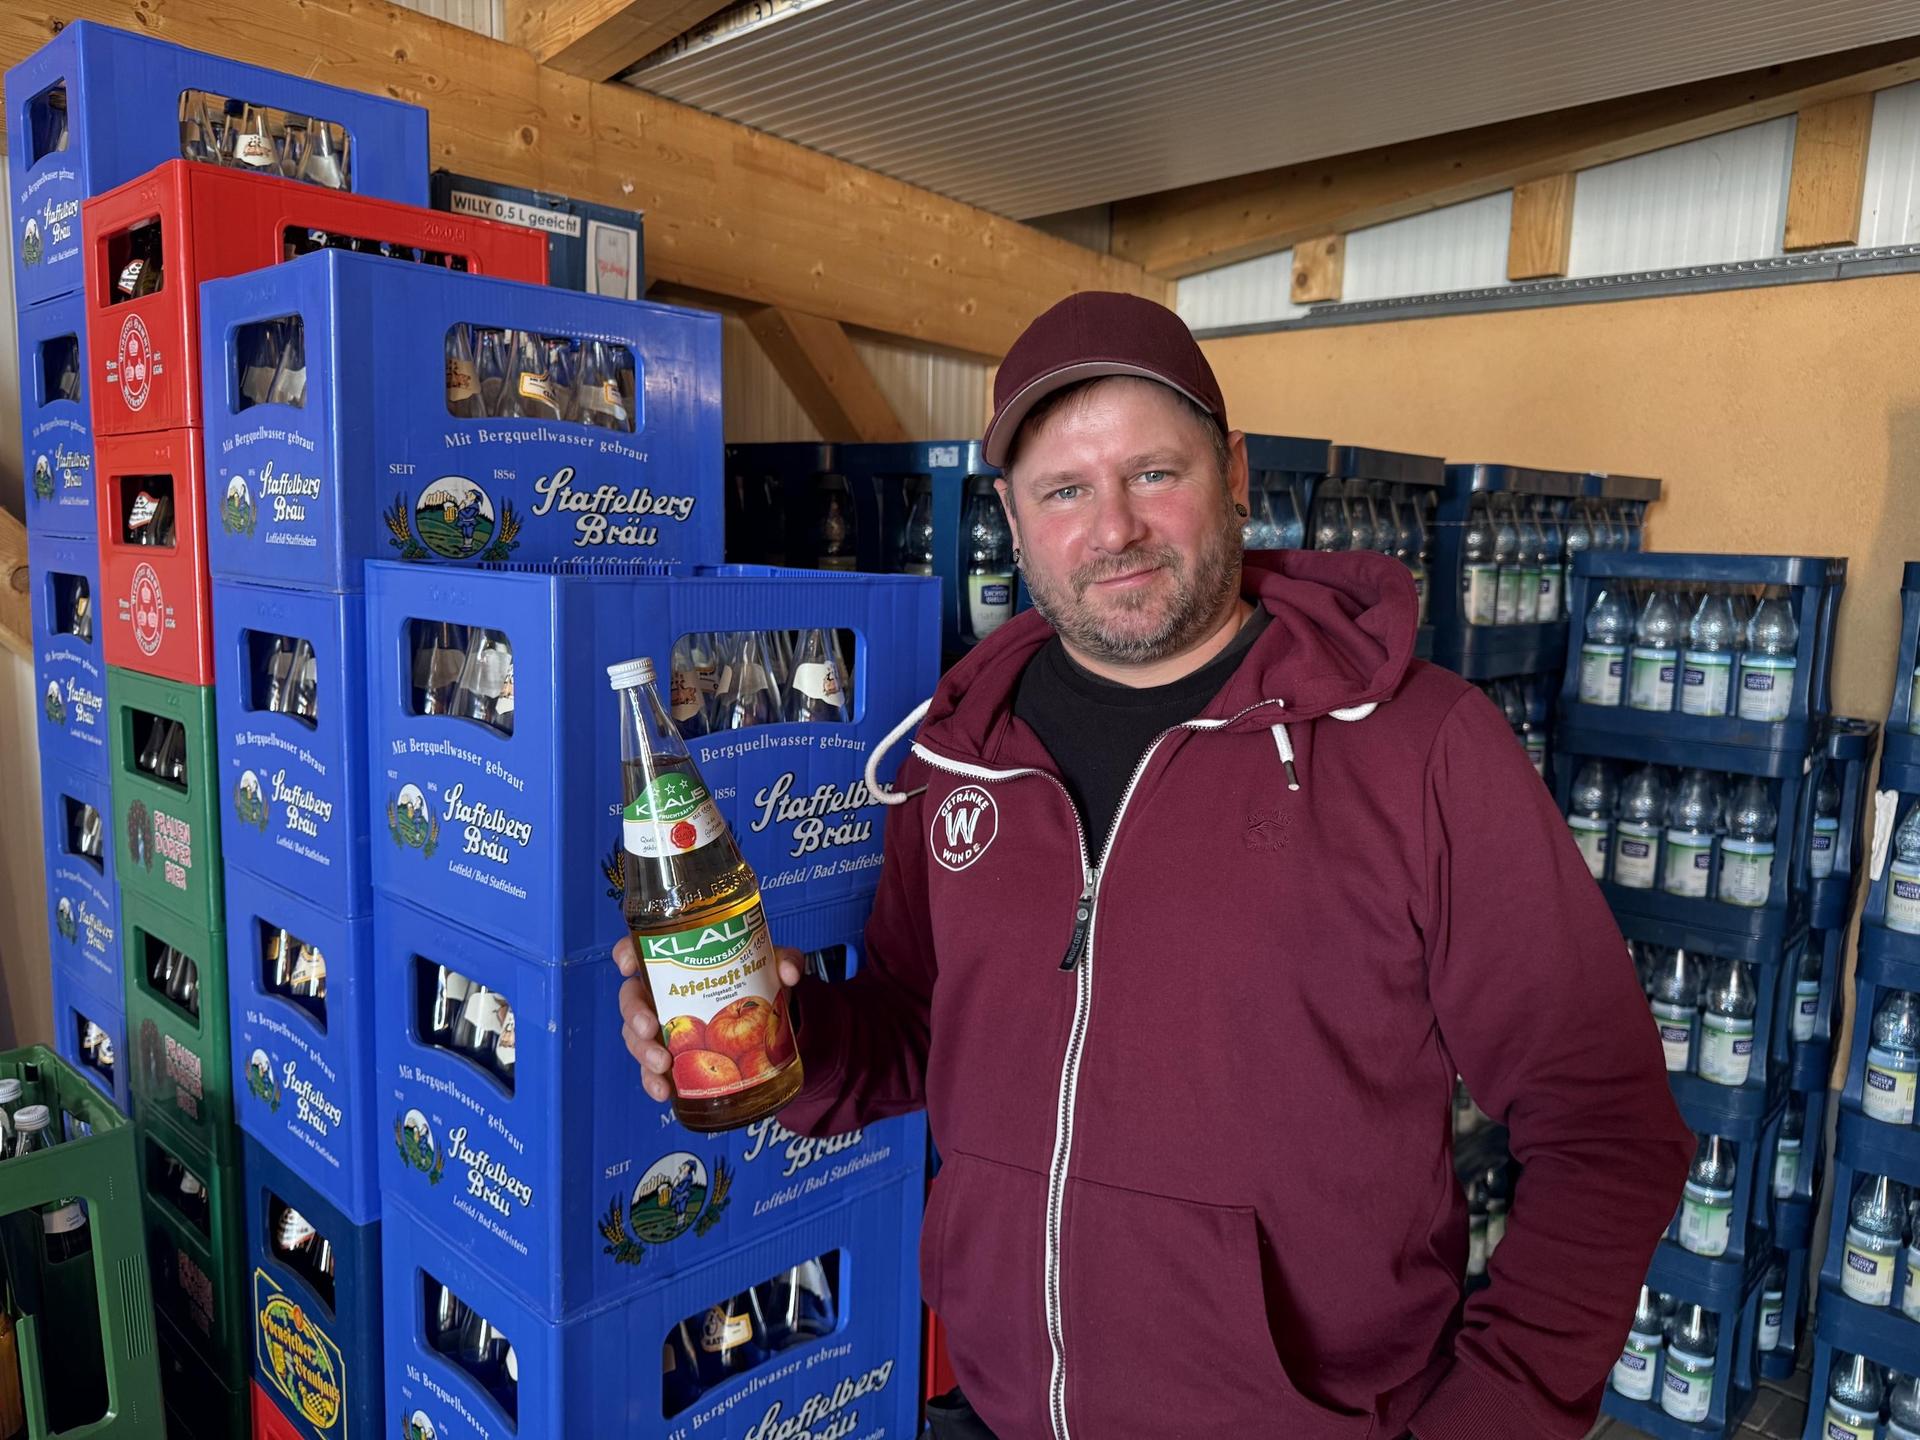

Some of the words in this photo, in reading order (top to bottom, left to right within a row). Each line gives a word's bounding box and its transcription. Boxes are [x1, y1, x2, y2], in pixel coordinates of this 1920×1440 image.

[453, 194, 491, 215] WILLY
[495, 203, 515, 220] 0,5
[518, 210, 525, 222] L
[529, 213, 579, 233] geeicht
[235, 426, 286, 447] Bergquellwasser
[288, 430, 315, 452] gebraut
[445, 433, 472, 449] Mit
[478, 428, 594, 448] Bergquellwasser
[600, 438, 649, 463] gebraut
[260, 460, 321, 499] Staffelberg
[389, 463, 416, 475] SEIT
[493, 469, 516, 481] 1856
[273, 494, 305, 522] Bräu
[531, 465, 695, 521] Staffelberg
[574, 513, 658, 548] Bräu
[300, 748, 326, 776] gebraut
[392, 740, 407, 756] Mit
[410, 738, 482, 766] Bergquellwasser
[486, 760, 524, 792] gebraut
[701, 734, 814, 763] Bergquellwasser
[820, 734, 866, 752] gebraut
[272, 768, 333, 823] Staffelberg
[635, 786, 706, 817] KLAUS
[714, 786, 736, 800] 1856
[751, 772, 894, 831] Staffelbr
[941, 789, 990, 817] GETRÄNKE
[286, 804, 318, 838] Bräu
[443, 782, 533, 847] Staffelberg
[658, 804, 695, 820] FRUCHTSÄFTE
[945, 807, 981, 848] W
[463, 825, 509, 864] Bräu
[790, 813, 872, 857] Bräu
[165, 860, 187, 890] BIER
[838, 853, 885, 874] Staffelst
[489, 874, 527, 900] Staffelstein
[648, 904, 764, 957] KLAUS
[1065, 928, 1084, 963] INDICODE
[683, 938, 747, 965] FRUCHTSÄFTE
[740, 949, 753, 963] seit
[668, 966, 741, 998] Apfelsaft
[743, 956, 767, 976] klar
[282, 1060, 342, 1128] Staffelberg
[399, 1063, 413, 1080] Mit
[415, 1067, 485, 1117] Bergquellwasser
[488, 1113, 524, 1155] gebraut
[296, 1097, 328, 1136] Bräu
[447, 1126, 532, 1207] Staffelberg
[605, 1159, 632, 1180] SEIT
[830, 1146, 891, 1183] Staffelstein
[466, 1168, 511, 1218] Bräu
[491, 1221, 529, 1256] Staffelstein
[692, 1360, 803, 1430] Bergquellwasser
[805, 1342, 853, 1368] gebraut
[744, 1359, 894, 1440] Staffelberg
[422, 1371, 490, 1440] Bergquellwasser
